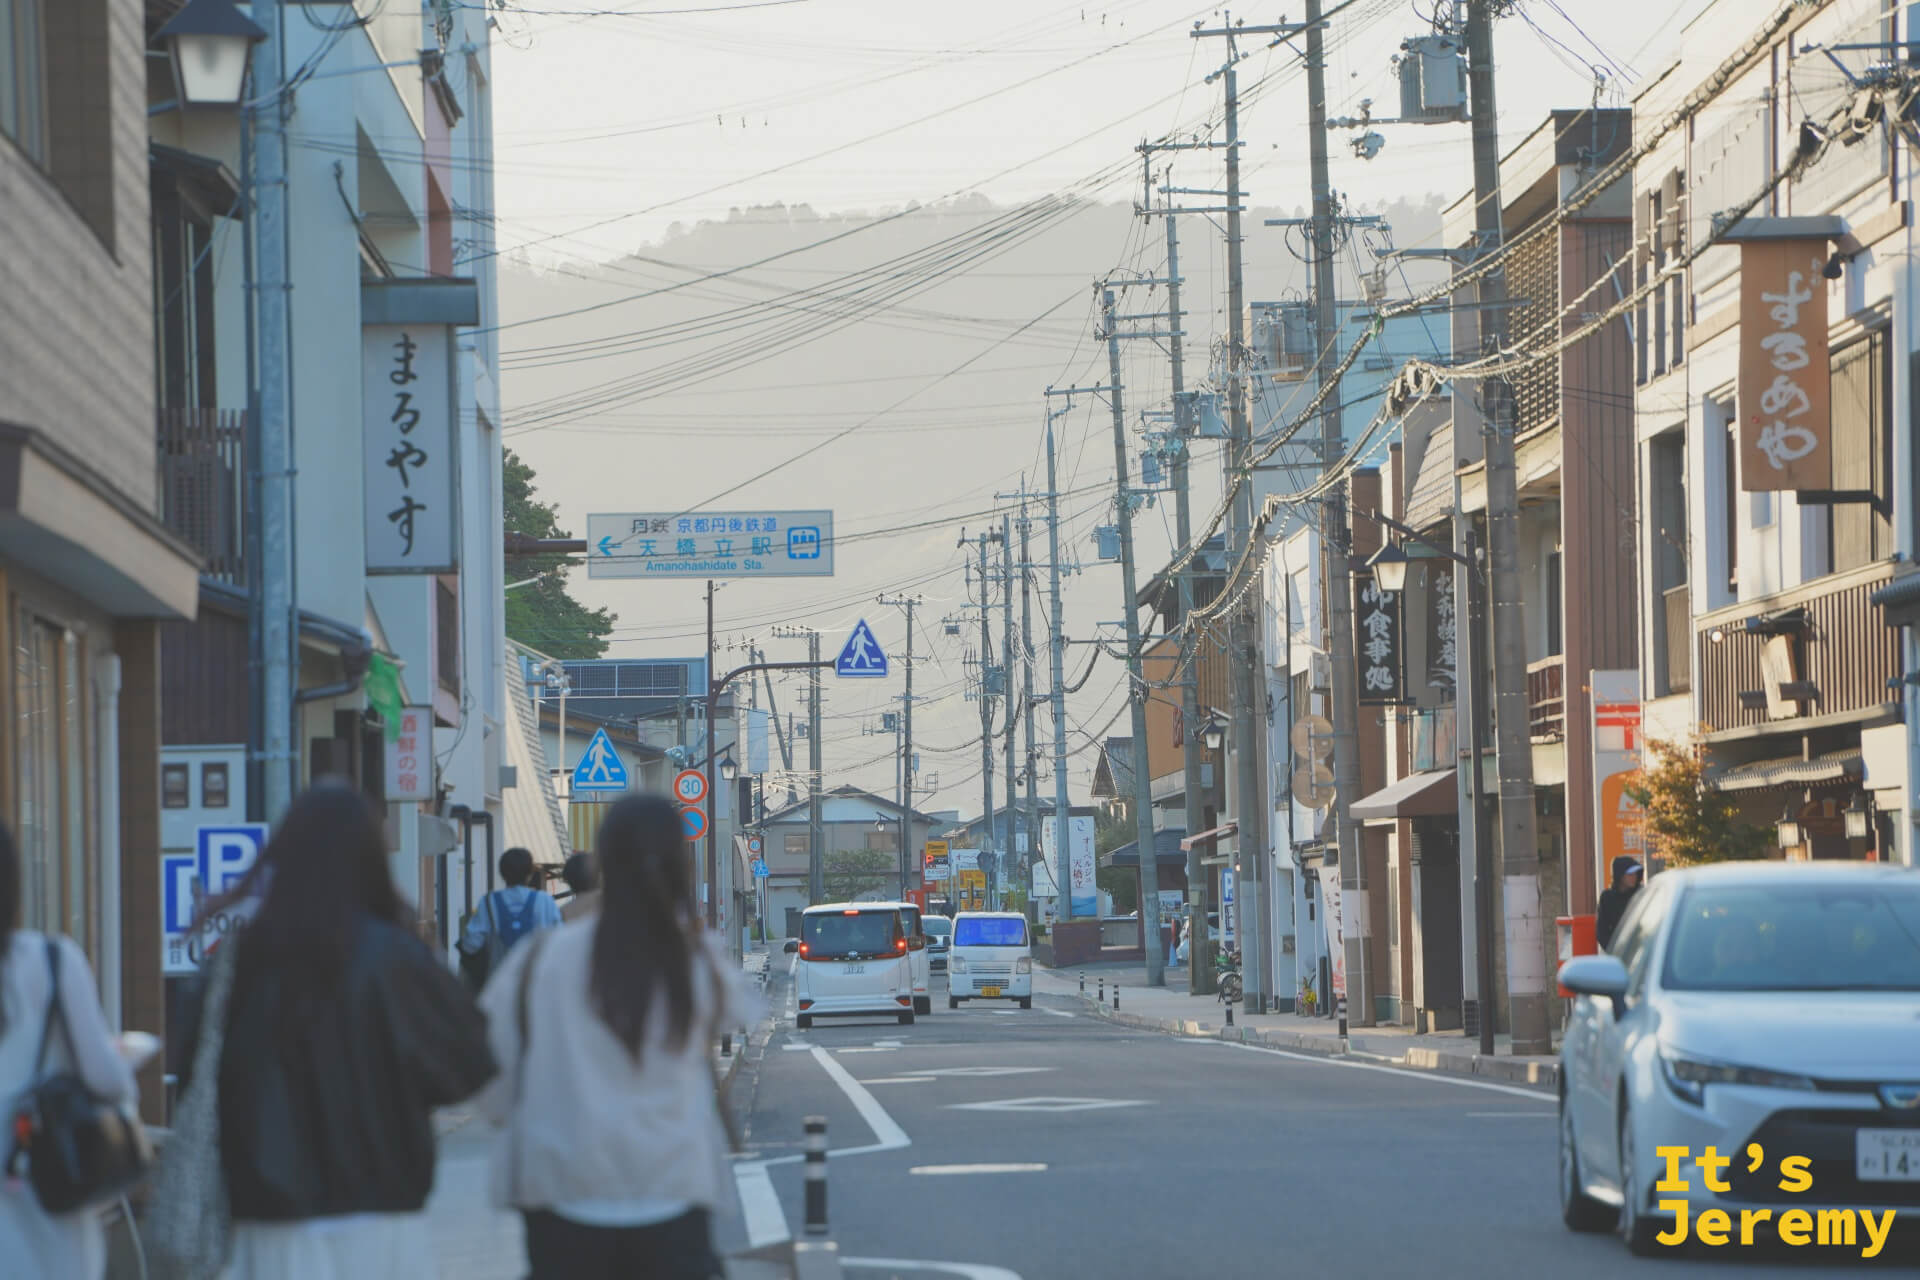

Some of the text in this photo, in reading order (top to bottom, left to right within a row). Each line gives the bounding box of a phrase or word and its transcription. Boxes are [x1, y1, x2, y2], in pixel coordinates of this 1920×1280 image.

[1757, 270, 1817, 471] するめや
[386, 333, 428, 557] まるやす
[632, 518, 777, 534] 丹鉄 京都丹後鉄道
[639, 537, 773, 558] 天橋立駅
[646, 560, 737, 572] Amanohashidate
[1361, 580, 1394, 690] 御食事処
[681, 779, 702, 795] 30
[207, 832, 258, 895] P
